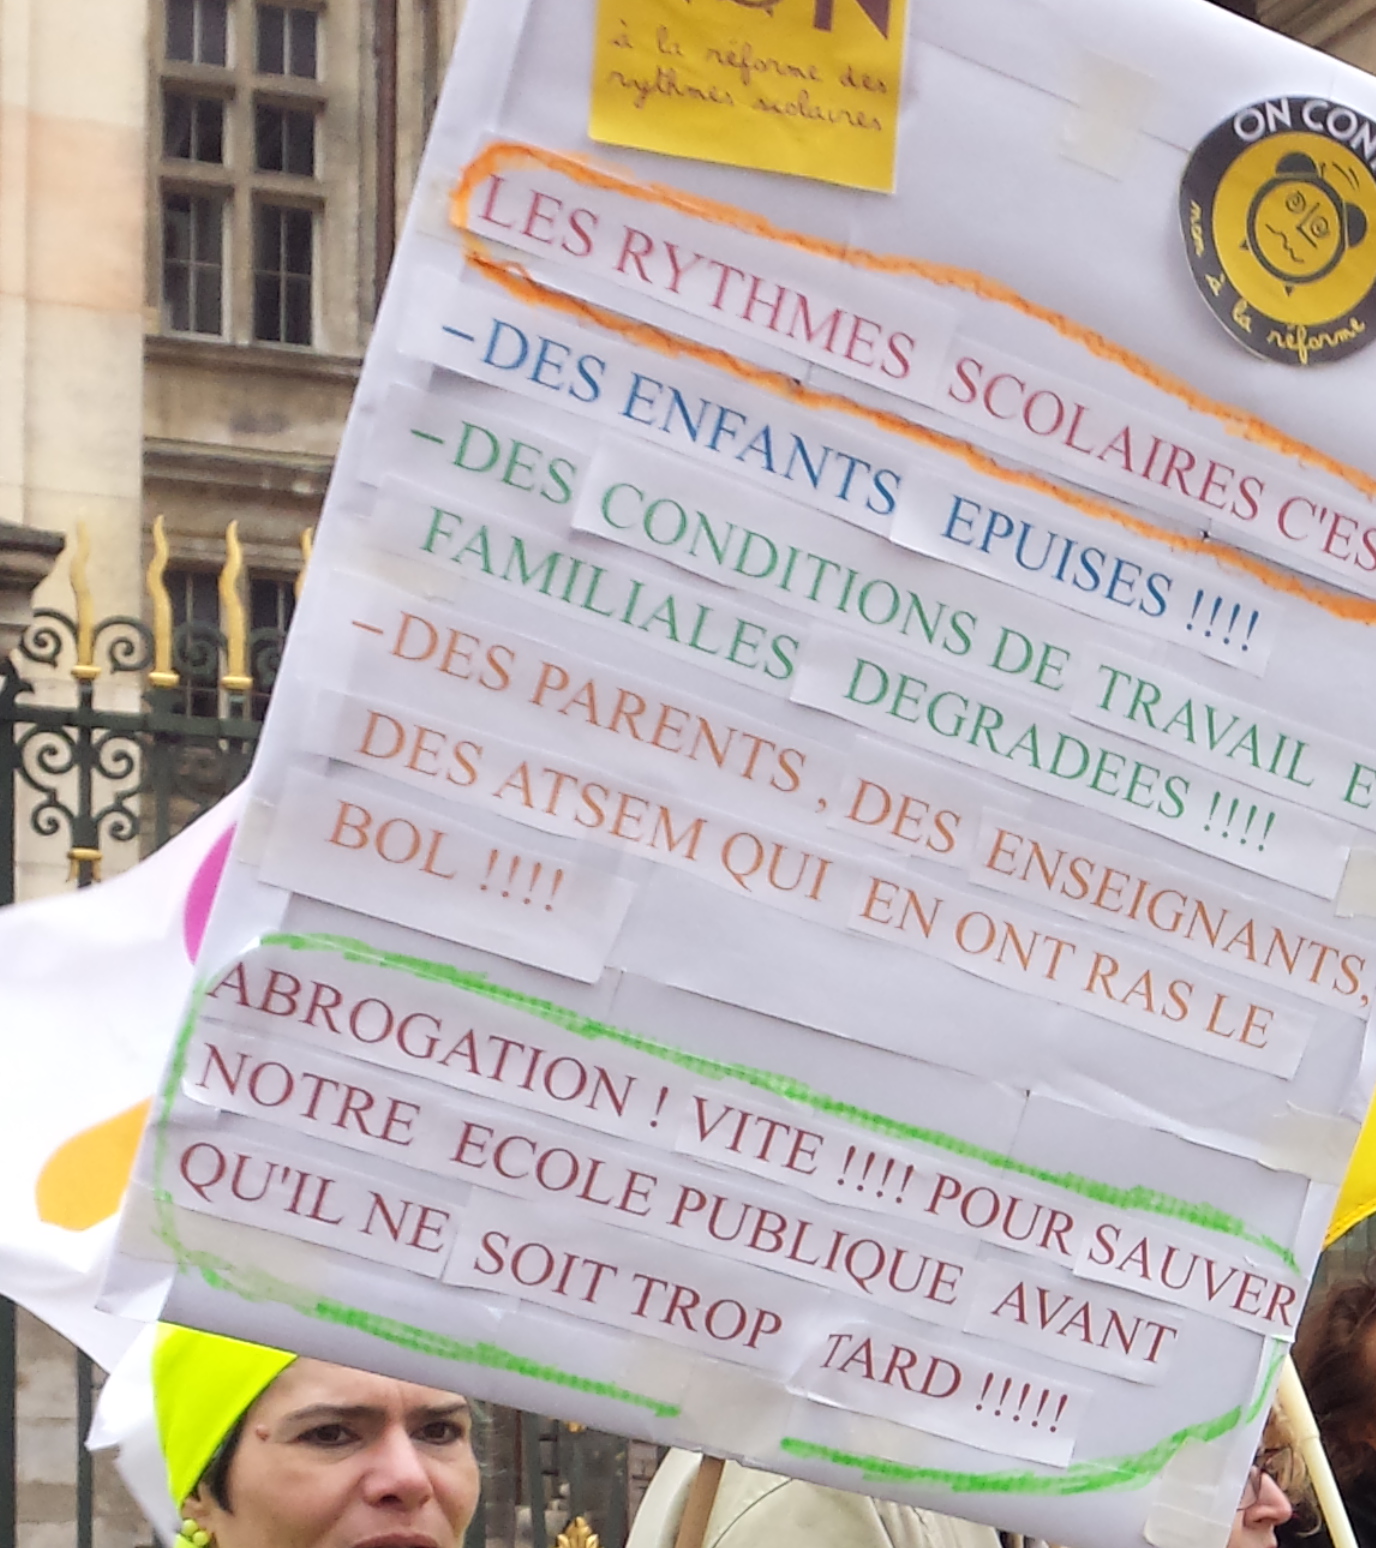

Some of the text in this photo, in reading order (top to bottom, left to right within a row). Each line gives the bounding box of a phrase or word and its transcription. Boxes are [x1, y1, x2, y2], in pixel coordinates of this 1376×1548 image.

[606, 66, 882, 132] rythmes scolaires
[656, 24, 684, 57] la
[706, 40, 822, 86] réforme
[838, 65, 888, 95] des
[1233, 97, 1293, 143] ON
[478, 174, 600, 259] LES
[615, 224, 916, 381] RYTHMES
[947, 356, 1267, 521] SCOLAIRES
[1266, 317, 1367, 366] réforme
[600, 482, 979, 658] CONDITIONS
[990, 626, 1071, 692] DE
[1093, 665, 1316, 788] TRAVAIL
[621, 371, 901, 517] ENFANTS
[940, 495, 1174, 619] EPUISES
[420, 506, 800, 682] FAMILIALES
[843, 657, 1190, 823] DEGRADEES
[325, 800, 456, 881] BOL
[358, 709, 1276, 1051] DES ATSEM QUI EN ONT RAS LE
[528, 660, 807, 795] PARENTS
[844, 777, 967, 855] DES
[983, 827, 1372, 1009] ENSEIGNANTS,
[179, 1142, 346, 1227] QU'IL
[360, 1191, 452, 1256] NE
[473, 1230, 619, 1305] SOIT
[628, 1272, 783, 1351] TROP
[819, 1331, 963, 1401] TARD
[196, 1042, 1180, 1366] NOTRE ECOLE PUBLIQUE AVANT
[204, 961, 639, 1119] ABROGATION
[692, 1094, 826, 1177] VITE
[923, 1172, 1079, 1259] POUR
[1088, 1223, 1300, 1330] SAUVER
